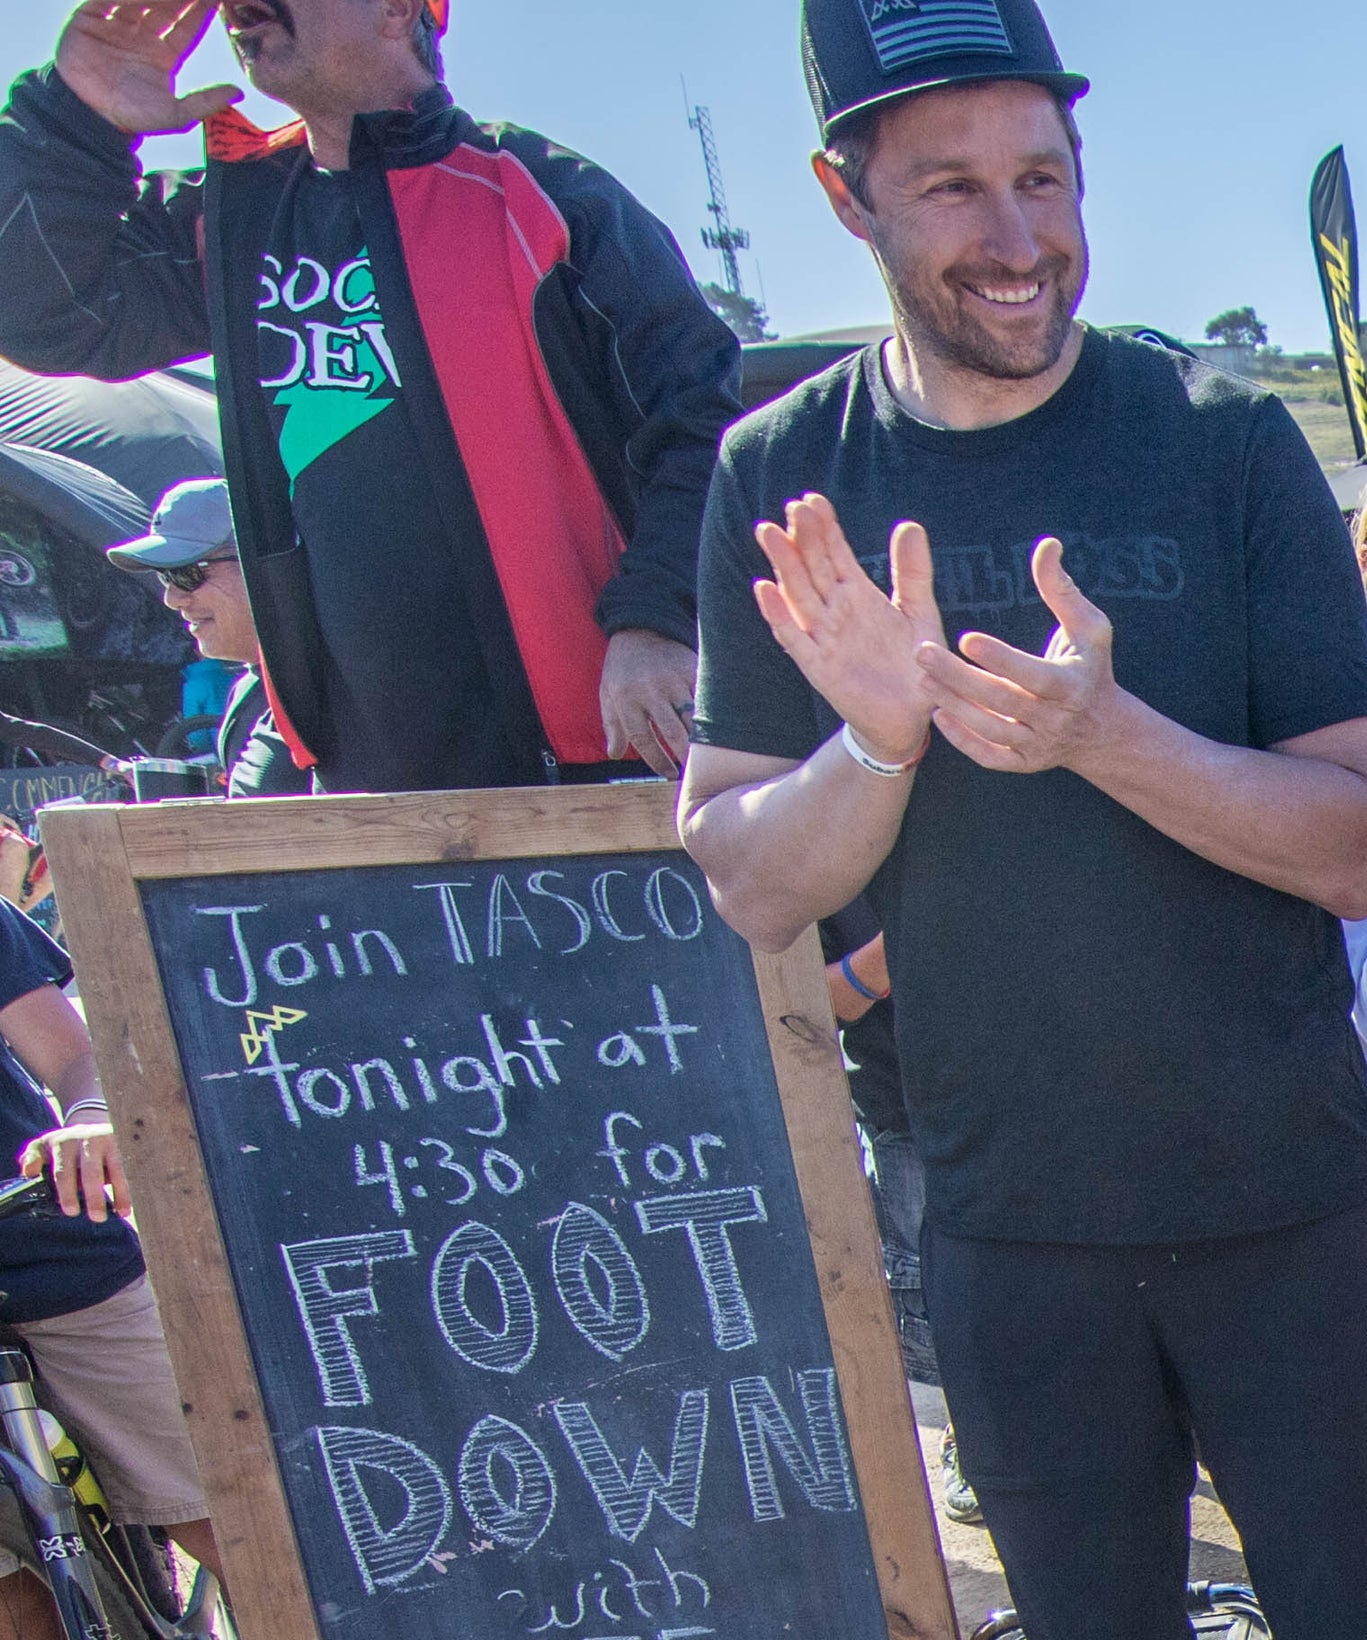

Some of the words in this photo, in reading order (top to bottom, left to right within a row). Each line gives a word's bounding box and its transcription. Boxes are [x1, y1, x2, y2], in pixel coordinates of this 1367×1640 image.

[199, 902, 408, 1009] Join
[412, 866, 708, 966] TASCO
[247, 1014, 575, 1139] tonight
[597, 986, 700, 1075] at
[354, 1142, 526, 1217] 4:30
[598, 1111, 728, 1186] for
[280, 1186, 768, 1407] FOOT
[313, 1368, 858, 1596] DOWN
[527, 1547, 712, 1635] with
